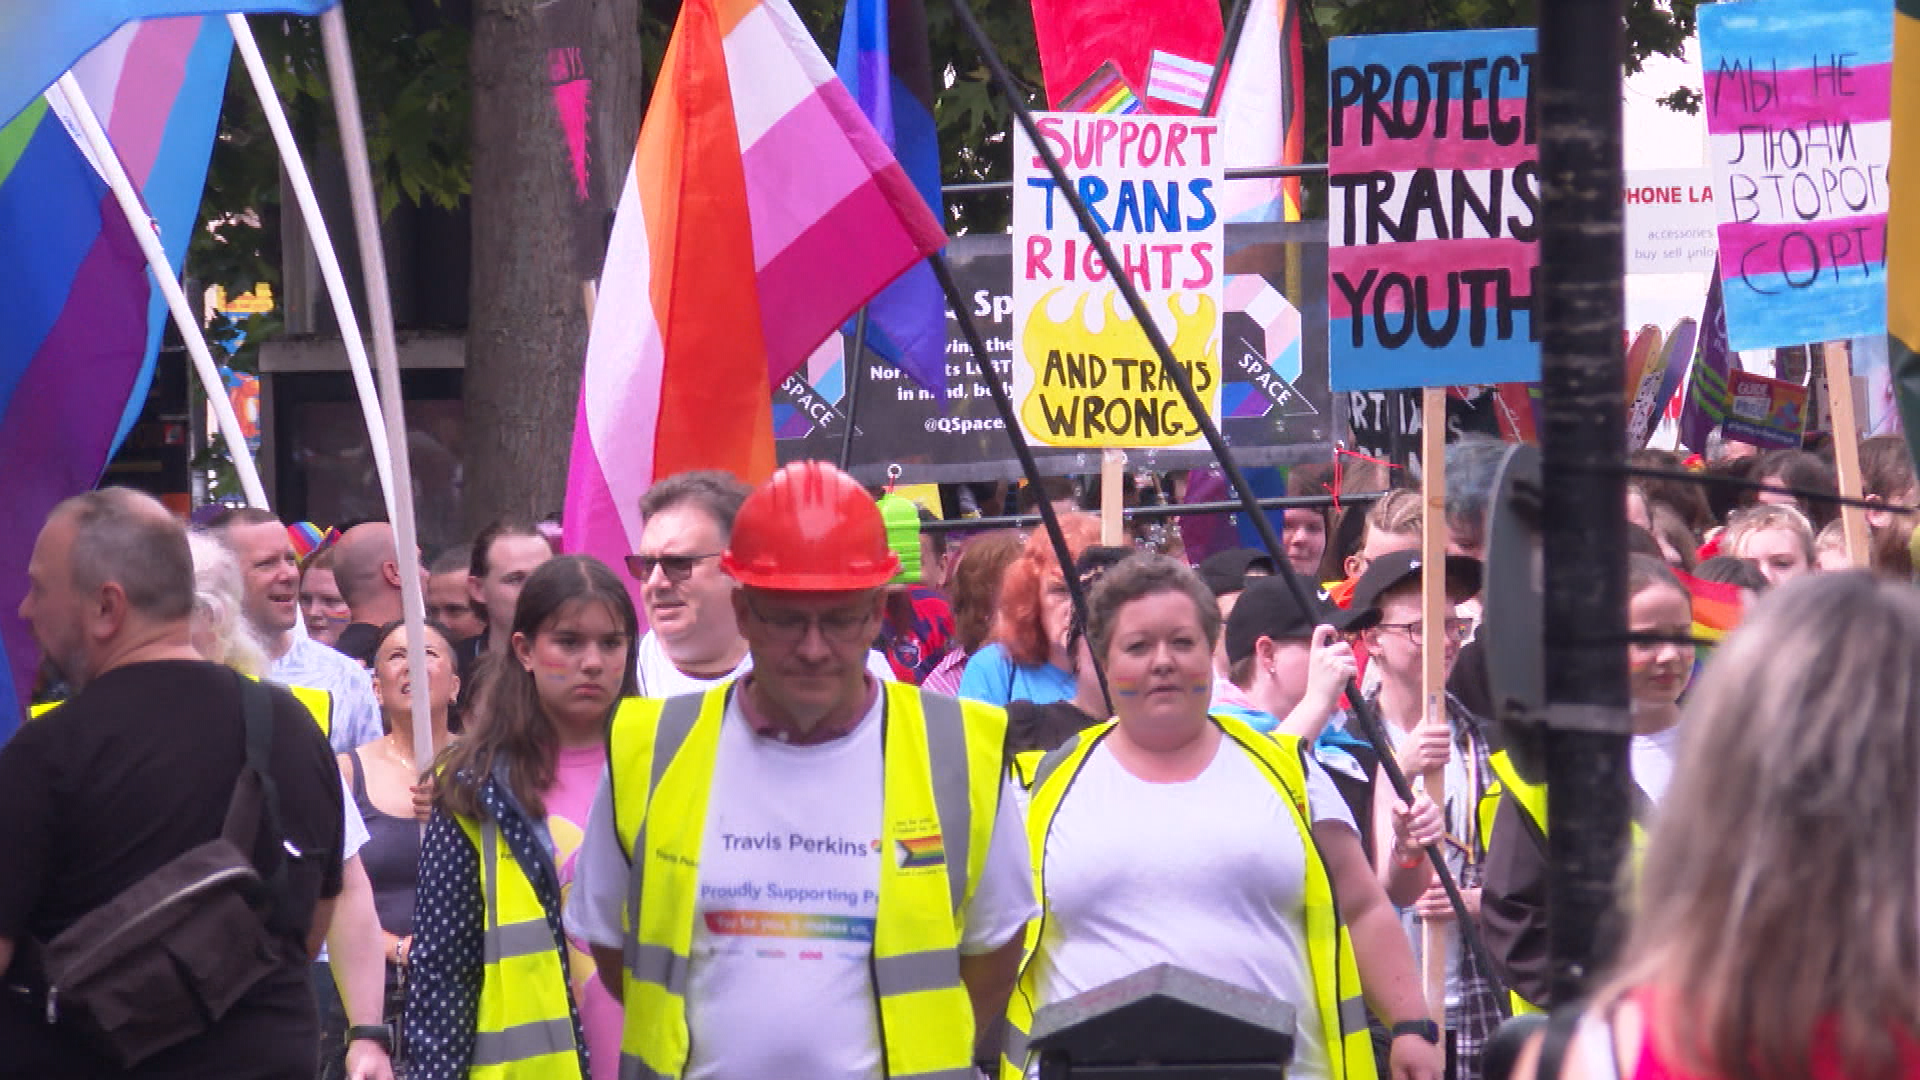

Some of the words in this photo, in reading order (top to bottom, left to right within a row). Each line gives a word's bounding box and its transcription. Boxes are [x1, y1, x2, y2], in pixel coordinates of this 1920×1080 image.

[1331, 54, 1540, 146] PROTECT
[1714, 56, 1779, 117] МЫ
[1813, 52, 1858, 97] НЕ
[1032, 118, 1217, 170] SUPPORT
[1728, 120, 1857, 172] ЛЮДИ
[1027, 175, 1216, 234] TRANS
[1330, 160, 1541, 246] TRANS
[1624, 186, 1682, 204] HONE
[1730, 165, 1886, 223] ВТОРОГ
[1026, 235, 1213, 292] RIGHTS
[1635, 248, 1656, 260] buy
[1687, 247, 1717, 260] unlo
[974, 290, 1013, 322] Sp
[1332, 266, 1541, 348] YOUTH
[898, 386, 914, 401] in
[1043, 350, 1107, 389] AND
[1238, 353, 1292, 406] SPACE
[781, 375, 835, 428] SPACE
[722, 832, 782, 851] Travis
[789, 833, 868, 856] Perkins
[701, 882, 761, 901] Proudly
[767, 883, 857, 907] Supporting
